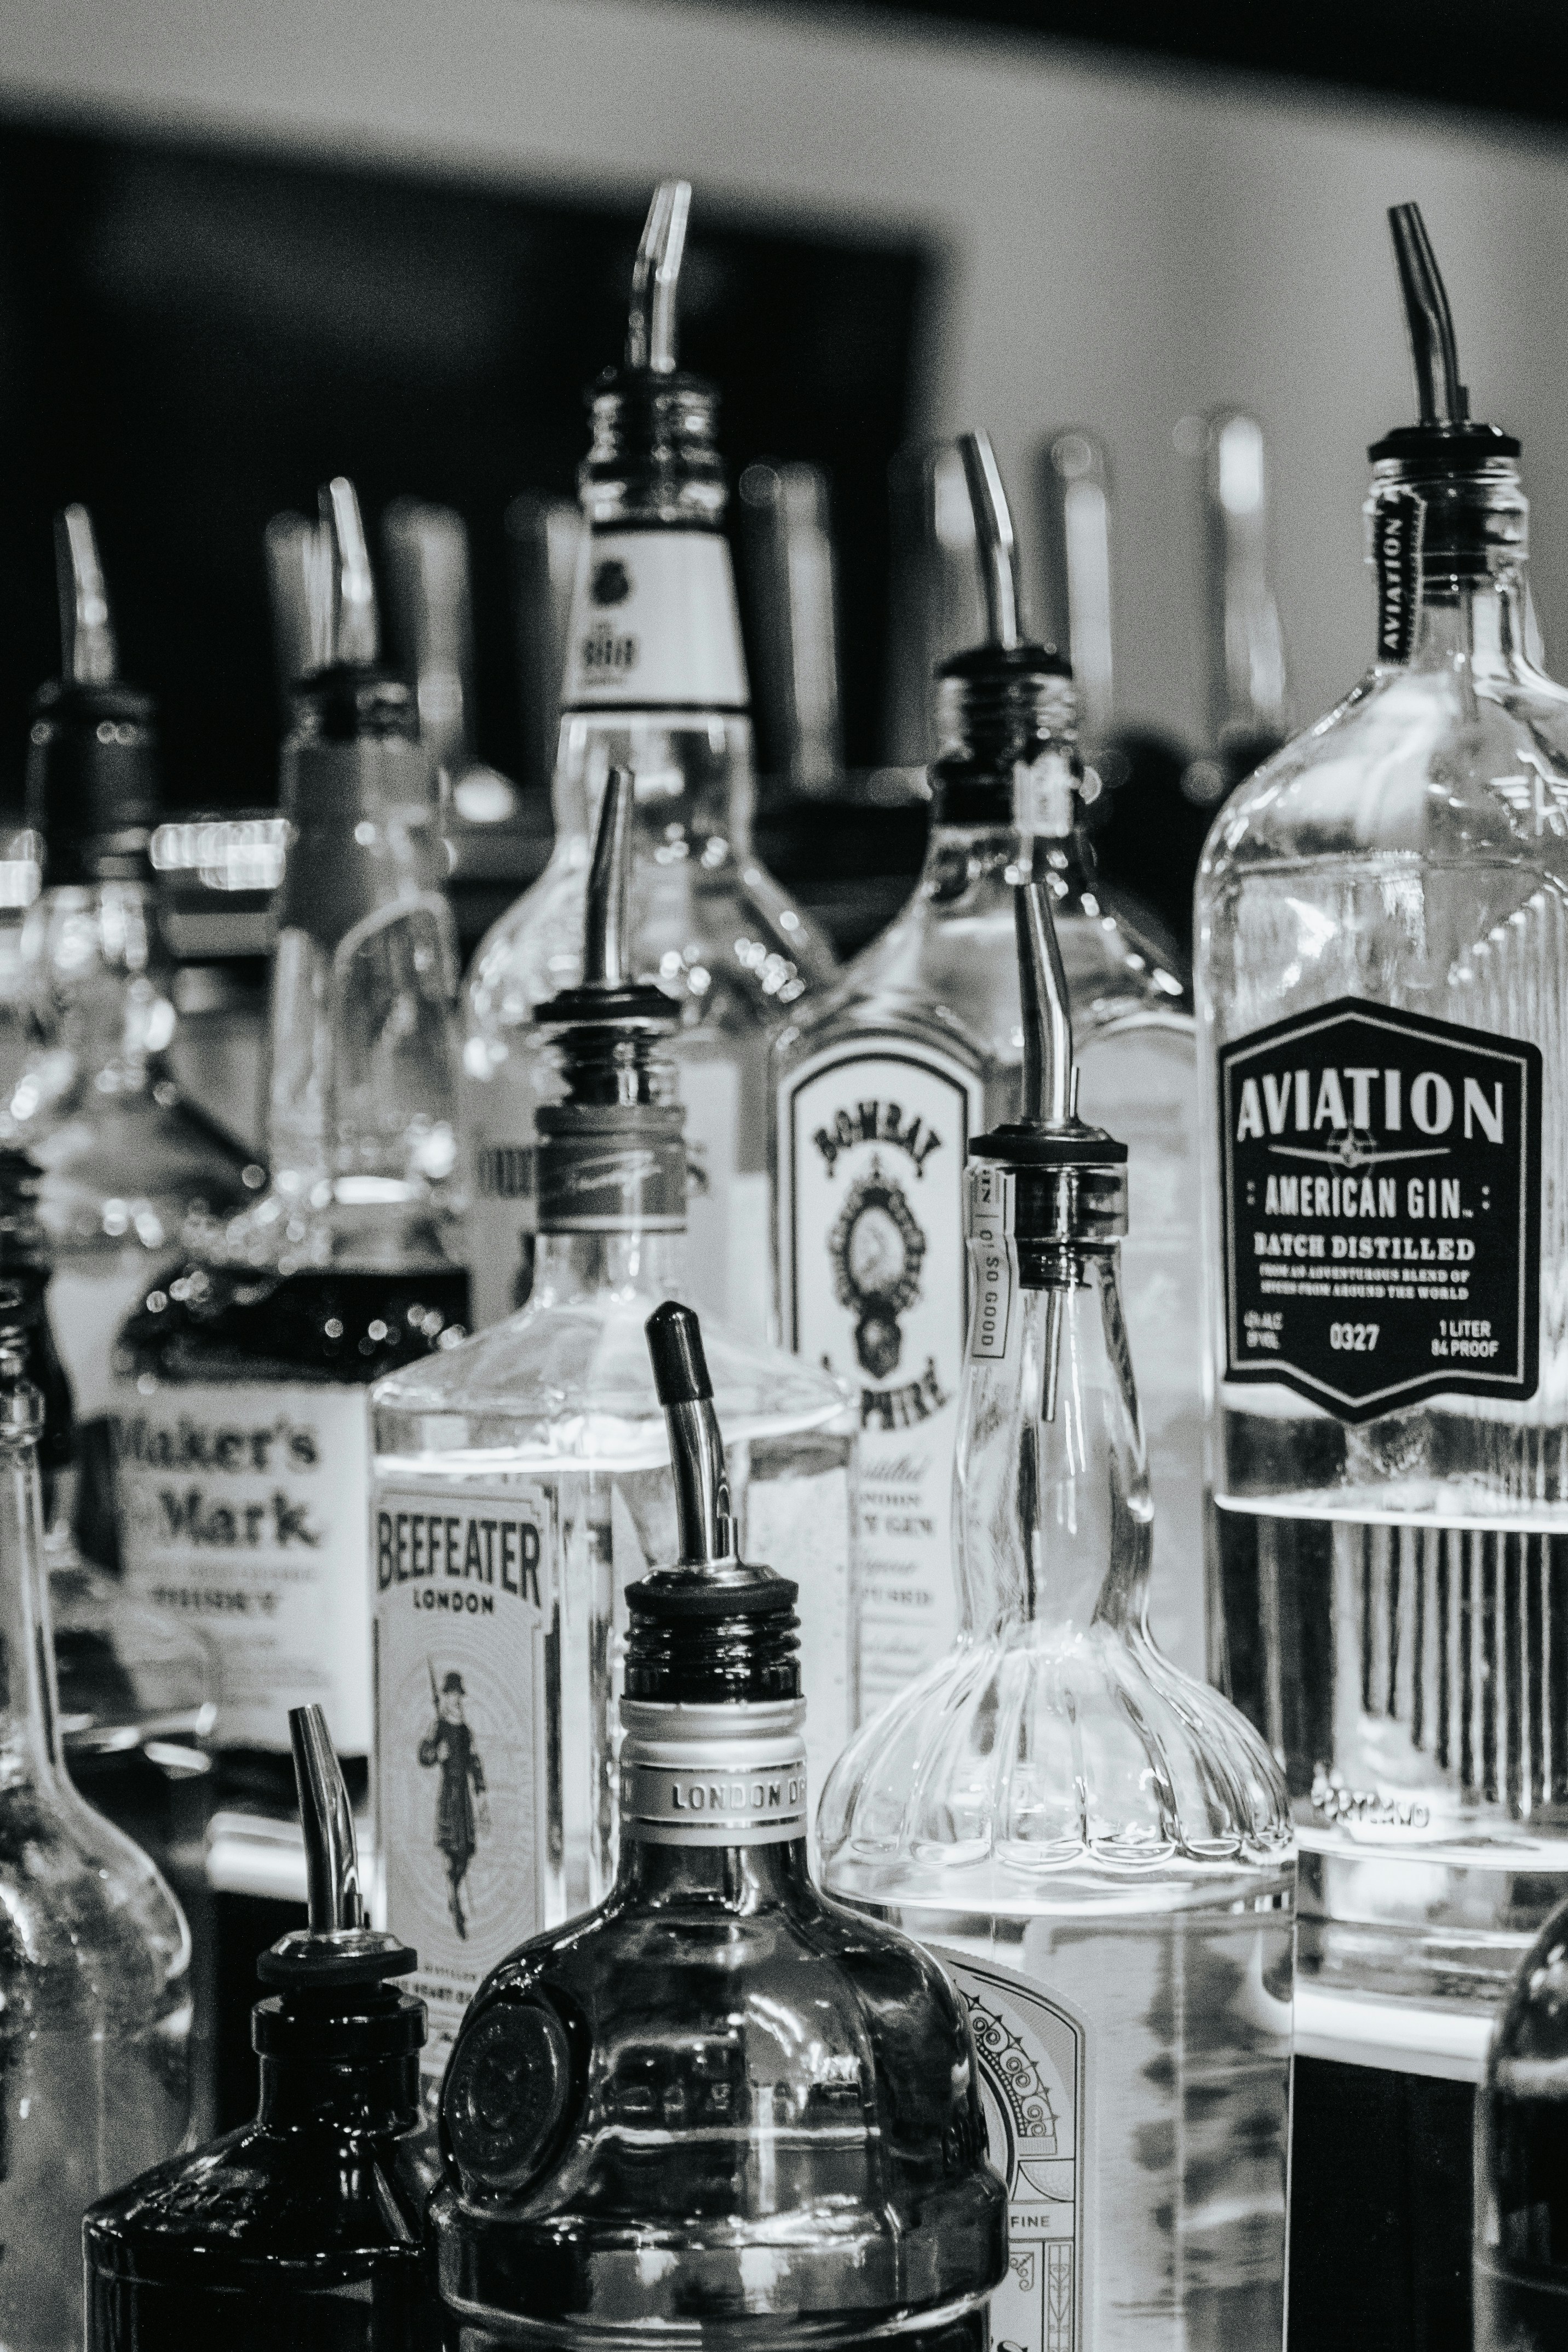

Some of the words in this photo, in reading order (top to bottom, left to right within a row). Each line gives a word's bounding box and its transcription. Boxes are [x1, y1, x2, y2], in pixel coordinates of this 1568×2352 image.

[1383, 518, 1403, 650] AVIATION
[1236, 1067, 1504, 1145] AVIATION
[813, 1098, 942, 1179] BOMBAY
[1264, 1174, 1397, 1218] AMERICAN
[1253, 1231, 1326, 1258] BATCH
[1331, 1235, 1476, 1261] DISTILLED
[985, 1257, 1000, 1282] SO
[1417, 1286, 1470, 1301] WORLD
[981, 1292, 998, 1346] GOOD
[1439, 1318, 1447, 1337] 1
[1449, 1318, 1492, 1338] LITER
[1330, 1322, 1380, 1352] 0327
[1450, 1339, 1500, 1358] PROOF
[158, 1485, 324, 1550] Mark
[377, 1509, 542, 1609] BEEFEATER
[413, 1588, 493, 1614] LONDON
[672, 1780, 781, 1810] LONDON
[1010, 2216, 1050, 2228] FINE
